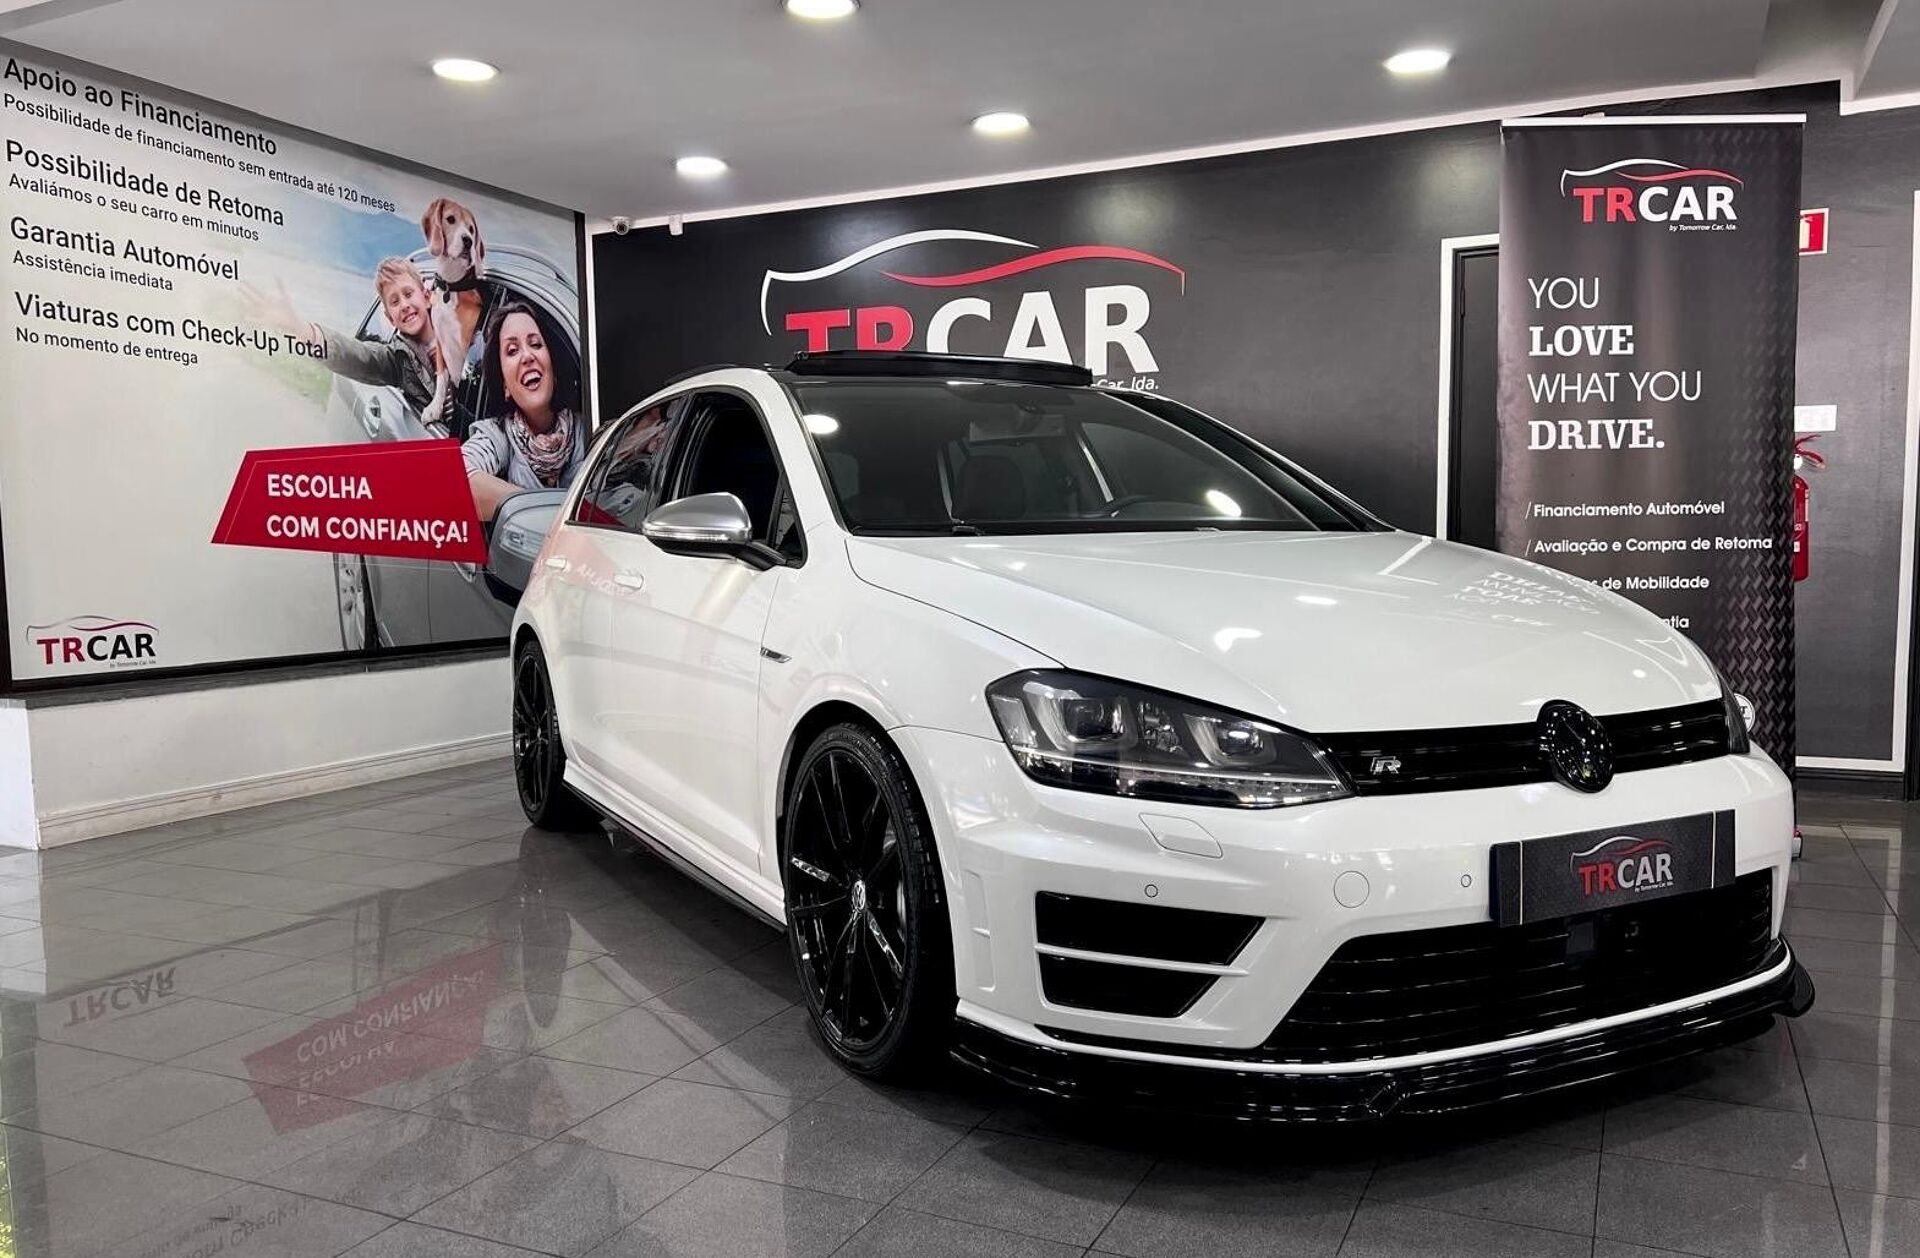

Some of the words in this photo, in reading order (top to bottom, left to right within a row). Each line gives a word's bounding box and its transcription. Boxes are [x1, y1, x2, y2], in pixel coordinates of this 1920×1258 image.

[4, 58, 77, 96] Apoio
[84, 85, 113, 107] ao
[121, 90, 277, 155] Financiamento
[4, 93, 110, 135] Possibilidade
[114, 123, 133, 141] de
[136, 129, 235, 168] financiamento
[238, 160, 266, 177] sem
[268, 169, 314, 190] entrada
[316, 182, 335, 196] até
[338, 186, 358, 203] 120
[360, 194, 396, 213] meses
[6, 139, 168, 198] Possibilidade
[175, 181, 201, 206] de
[207, 189, 284, 226] Retoma
[9, 173, 93, 204] Avaliámos
[96, 195, 107, 208] o
[110, 199, 137, 215] seu
[141, 204, 178, 224] carro
[182, 214, 203, 230] em
[207, 219, 260, 242] minutos
[1573, 186, 1738, 224] TRCAR
[10, 216, 115, 257] Garantia
[123, 238, 239, 281] Automóvel
[12, 250, 106, 279] Assistência
[110, 266, 174, 291] imediata
[1527, 277, 1600, 309] YOU
[14, 291, 120, 329] Viaturas
[126, 313, 175, 337] com
[182, 319, 280, 356] Check-Up
[284, 334, 329, 360] Total
[785, 284, 1160, 375] TRCAR
[1528, 325, 1635, 357] LOVE
[16, 326, 39, 344] No
[44, 333, 120, 355] momento
[123, 342, 142, 358] de
[145, 347, 198, 367] entrega
[1527, 372, 1620, 404] WHAT
[1628, 370, 1702, 402] YOU
[1527, 418, 1666, 451] DRIVE.
[266, 473, 374, 500] ESCOLHA
[1645, 500, 1725, 516] Automóvel
[266, 514, 320, 539] COM
[326, 516, 469, 549] CONFIANÇA!
[1611, 540, 1622, 552] e
[1625, 537, 1687, 554] Compra
[1690, 536, 1712, 551] de
[1715, 536, 1773, 550] Retoma
[1601, 577, 1622, 590] de
[1625, 575, 1710, 590] Mobilidade
[36, 633, 156, 665] TRCAR
[1578, 853, 1674, 897] TRCAR
